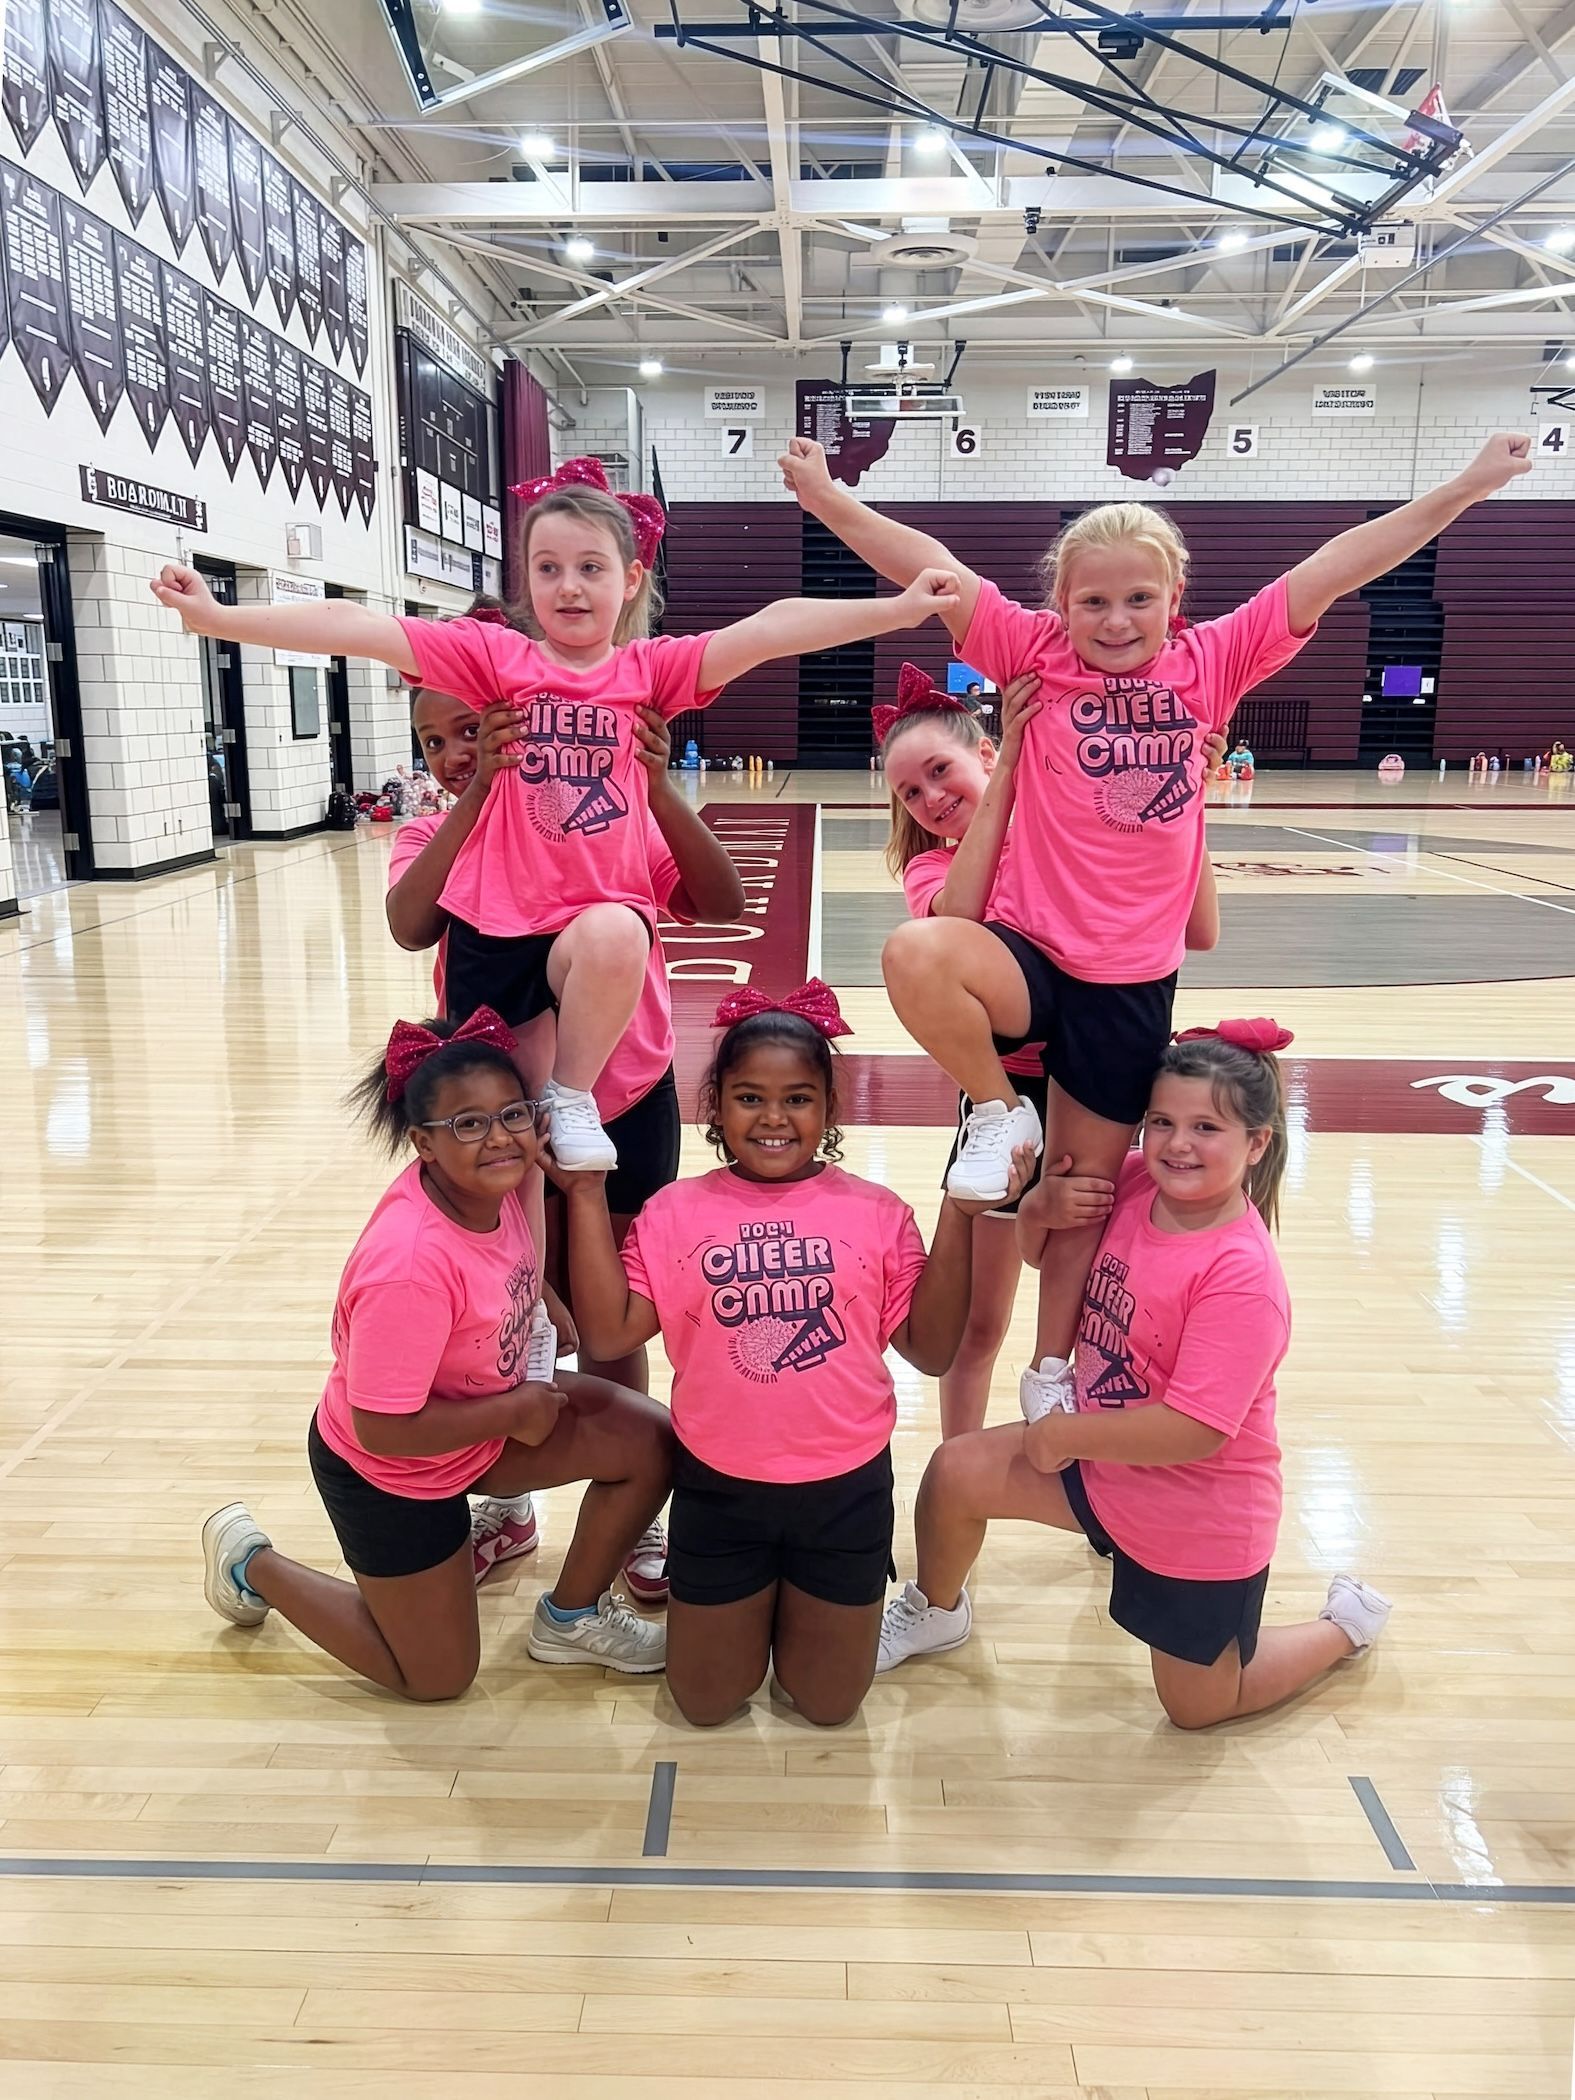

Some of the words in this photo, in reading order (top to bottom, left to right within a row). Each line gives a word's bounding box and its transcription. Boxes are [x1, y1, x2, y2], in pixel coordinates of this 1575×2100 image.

[727, 429, 747, 454] 7
[956, 429, 976, 454] 6
[1233, 429, 1252, 454] 5
[1542, 427, 1564, 452] 4
[525, 703, 619, 746] HEER
[520, 743, 614, 784] CAMP
[1077, 731, 1194, 777] CAMP
[701, 1237, 835, 1286] CHEER
[711, 1276, 834, 1327] CAMP
